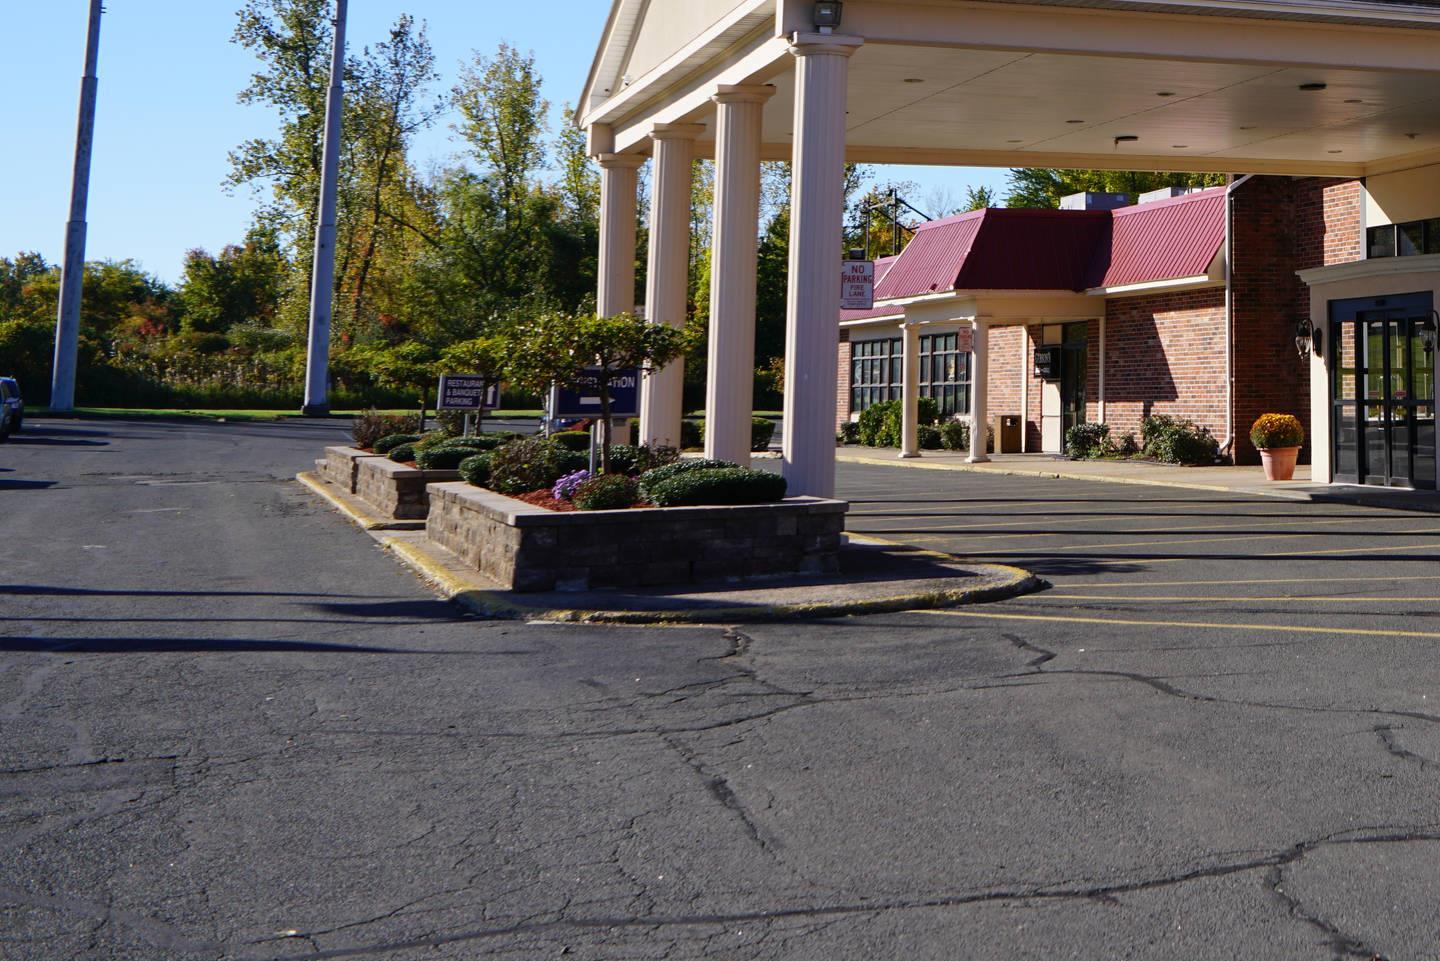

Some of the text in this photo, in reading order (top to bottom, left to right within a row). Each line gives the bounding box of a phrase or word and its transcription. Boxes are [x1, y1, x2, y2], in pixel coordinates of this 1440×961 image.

[851, 265, 865, 274] NO
[843, 274, 872, 284] PARKING
[447, 379, 485, 387] RESTAURAN
[445, 397, 473, 406] PARKING
